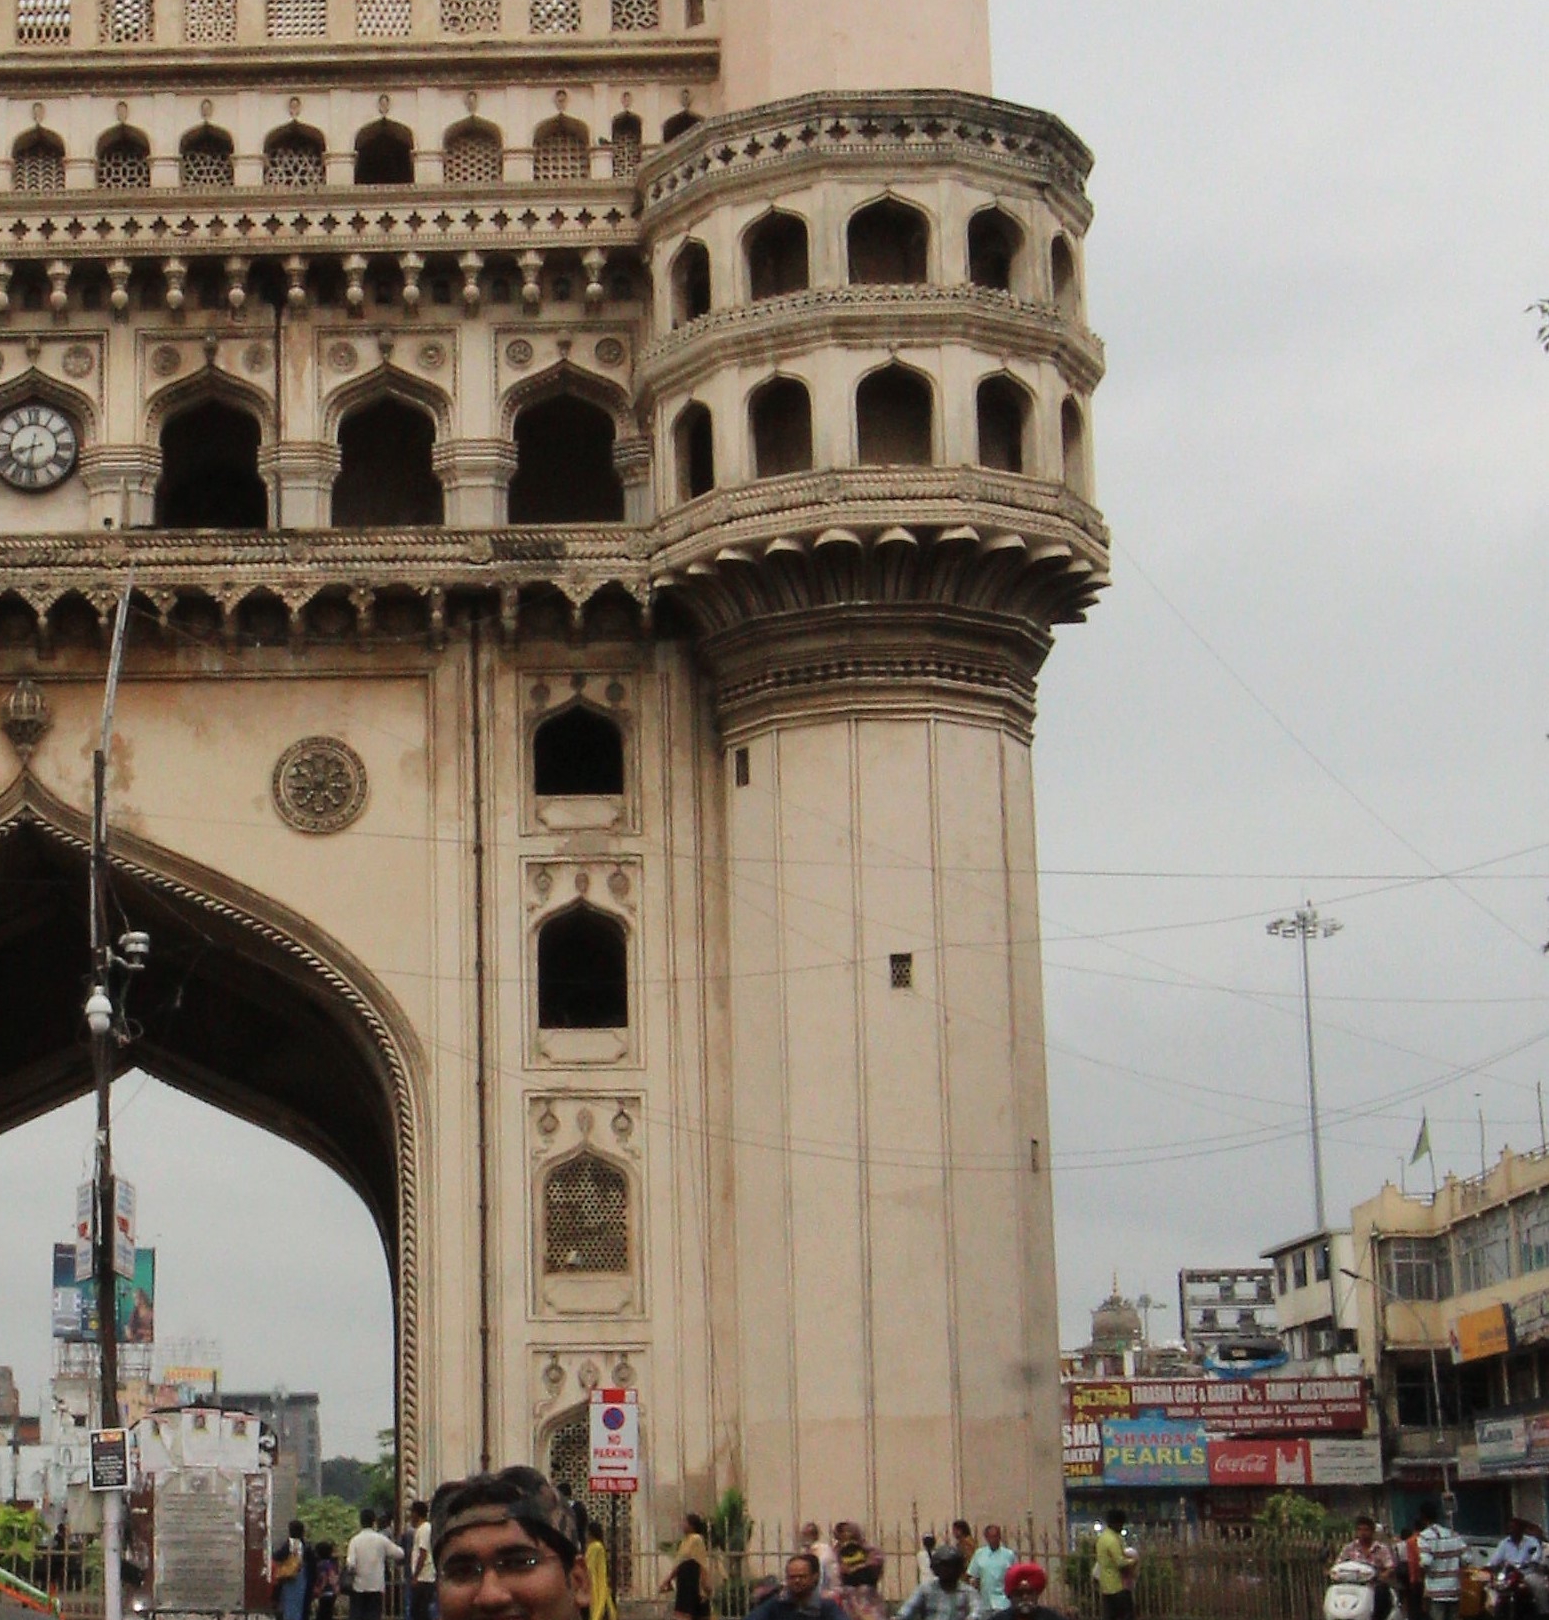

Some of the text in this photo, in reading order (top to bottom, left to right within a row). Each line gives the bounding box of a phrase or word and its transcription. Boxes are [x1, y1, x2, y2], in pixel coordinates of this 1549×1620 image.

[1300, 1380, 1361, 1401] RESTAURANT
[607, 1434, 621, 1446] NO
[1113, 1433, 1197, 1446] SHAADAN
[593, 1448, 634, 1459] PARKING
[1103, 1447, 1206, 1465] PEARLS
